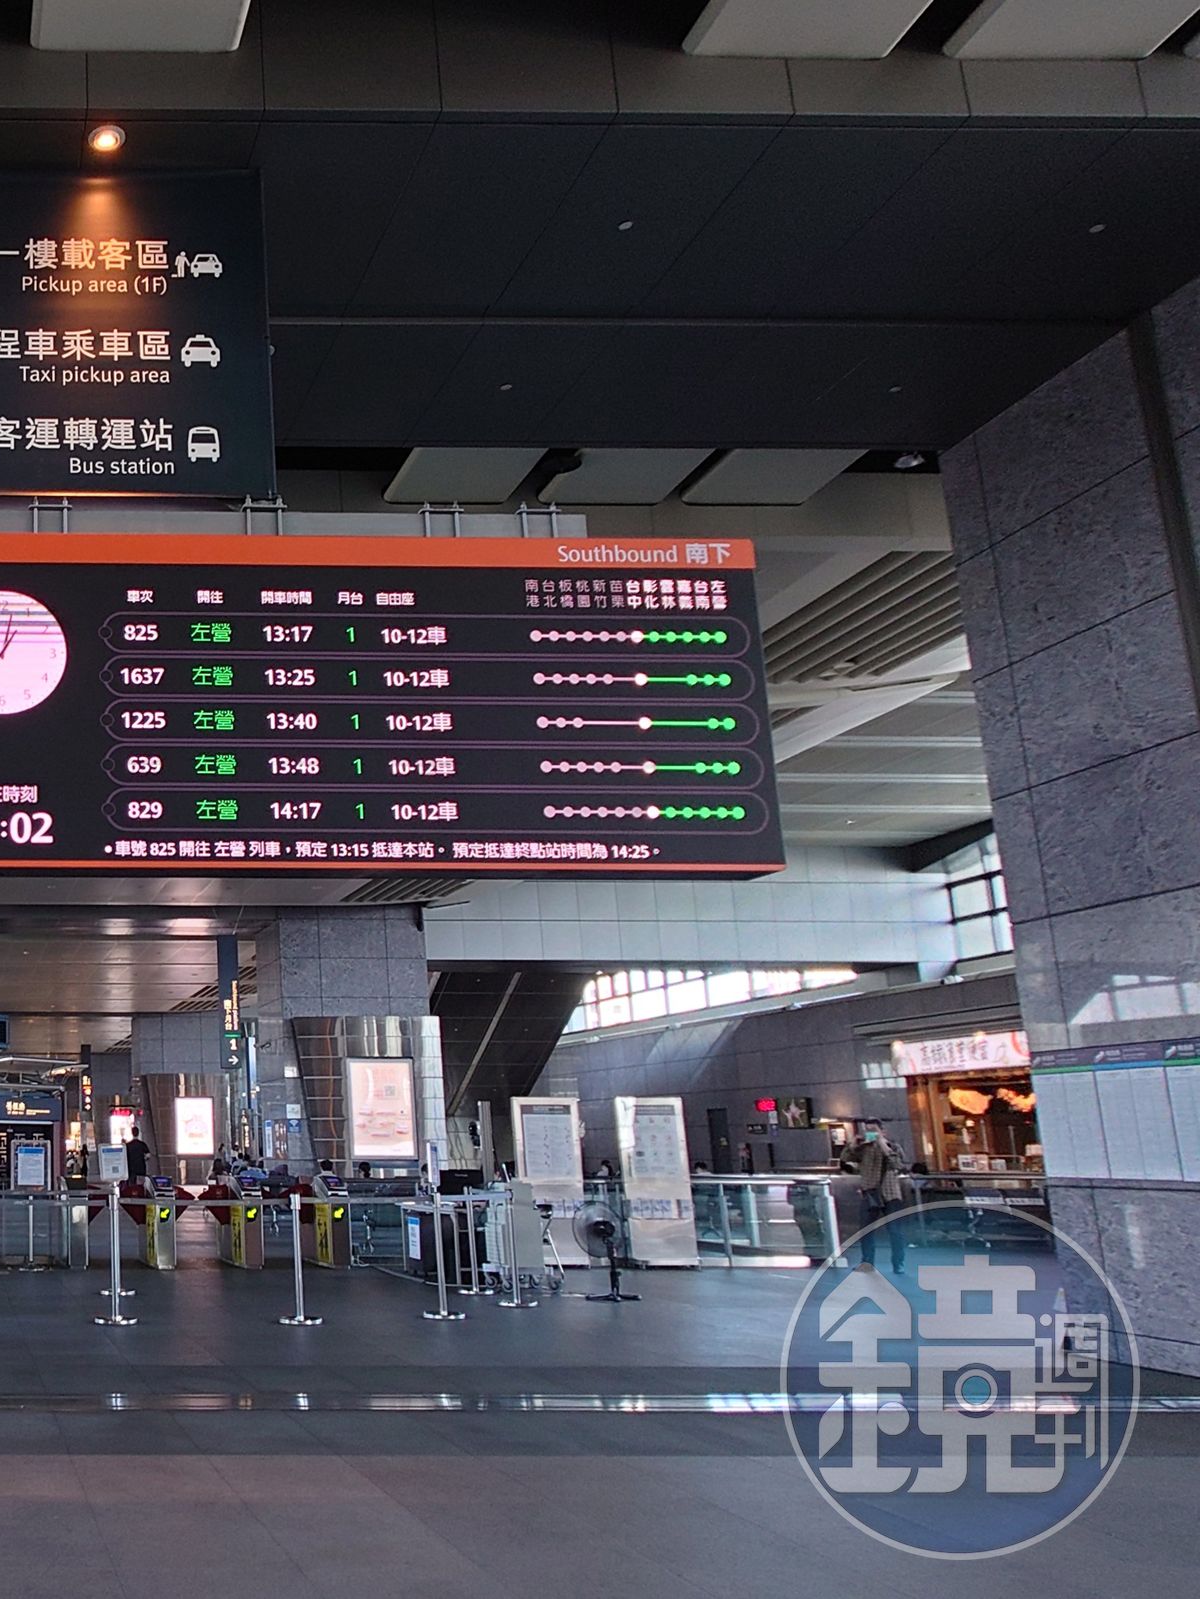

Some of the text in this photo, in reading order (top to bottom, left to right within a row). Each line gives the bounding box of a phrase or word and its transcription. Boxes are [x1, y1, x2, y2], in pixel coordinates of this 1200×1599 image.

[21, 275, 169, 296] Pickup area (1F)
[19, 365, 171, 387] Taxi pickup area
[69, 457, 175, 476] Bus station
[558, 543, 731, 564] Southbound 南下
[127, 590, 414, 605] 車次 開往 開車時間 月台 自由座
[124, 623, 446, 645] 825 左營 13:17 1 10-12車
[49, 648, 56, 659] 3
[41, 672, 49, 683] 4
[121, 666, 449, 688] 1637 左營 13:25 1 10-12車
[24, 690, 30, 700] 5
[122, 710, 452, 731] 1225 左營 13:40 1 10-12車
[127, 755, 455, 776] 639 左營 13:48 1 10-12車
[128, 800, 458, 821] 829 左營 14:17 1 10-12車
[115, 841, 147, 856] 車號
[150, 843, 176, 856] 825
[179, 841, 211, 857] 開往
[214, 842, 245, 857] 左營
[331, 844, 368, 857] 13:15
[230, 1039, 237, 1050] 1
